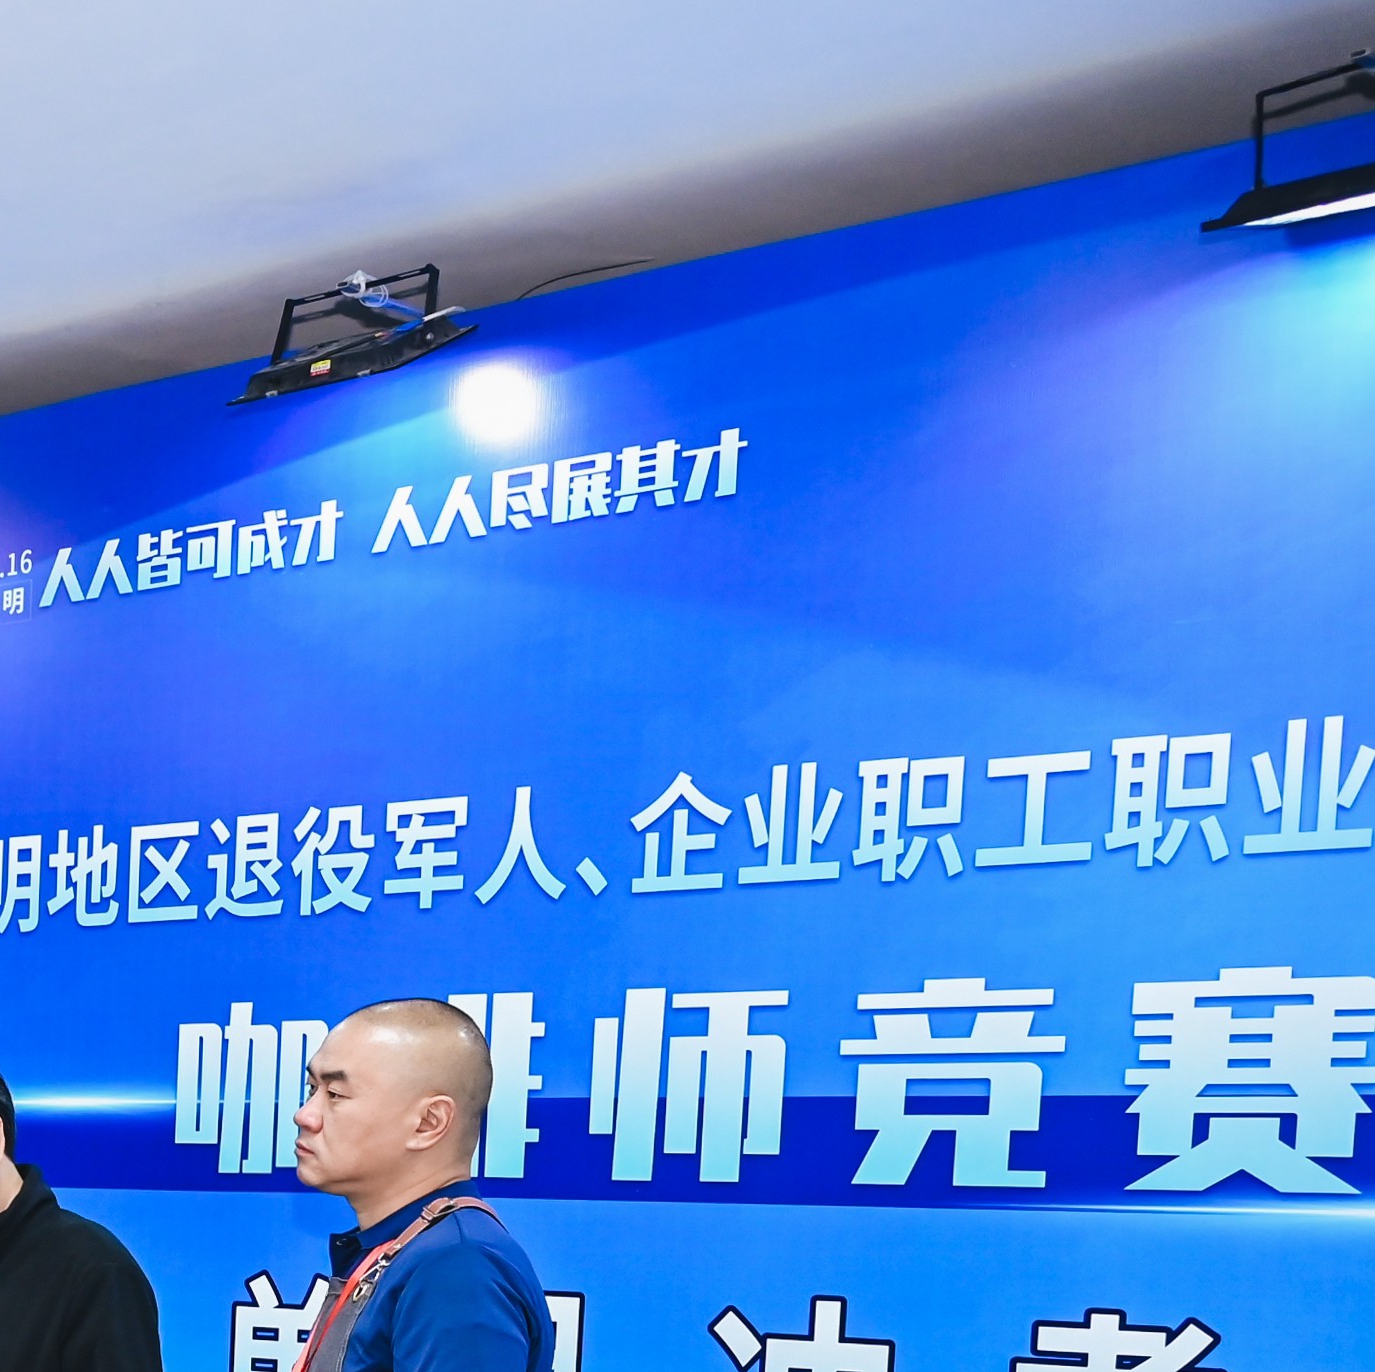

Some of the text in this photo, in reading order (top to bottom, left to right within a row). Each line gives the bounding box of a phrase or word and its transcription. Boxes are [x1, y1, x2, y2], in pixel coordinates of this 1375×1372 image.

[38, 428, 749, 608] 人人皆可成才 人人尽展其才
